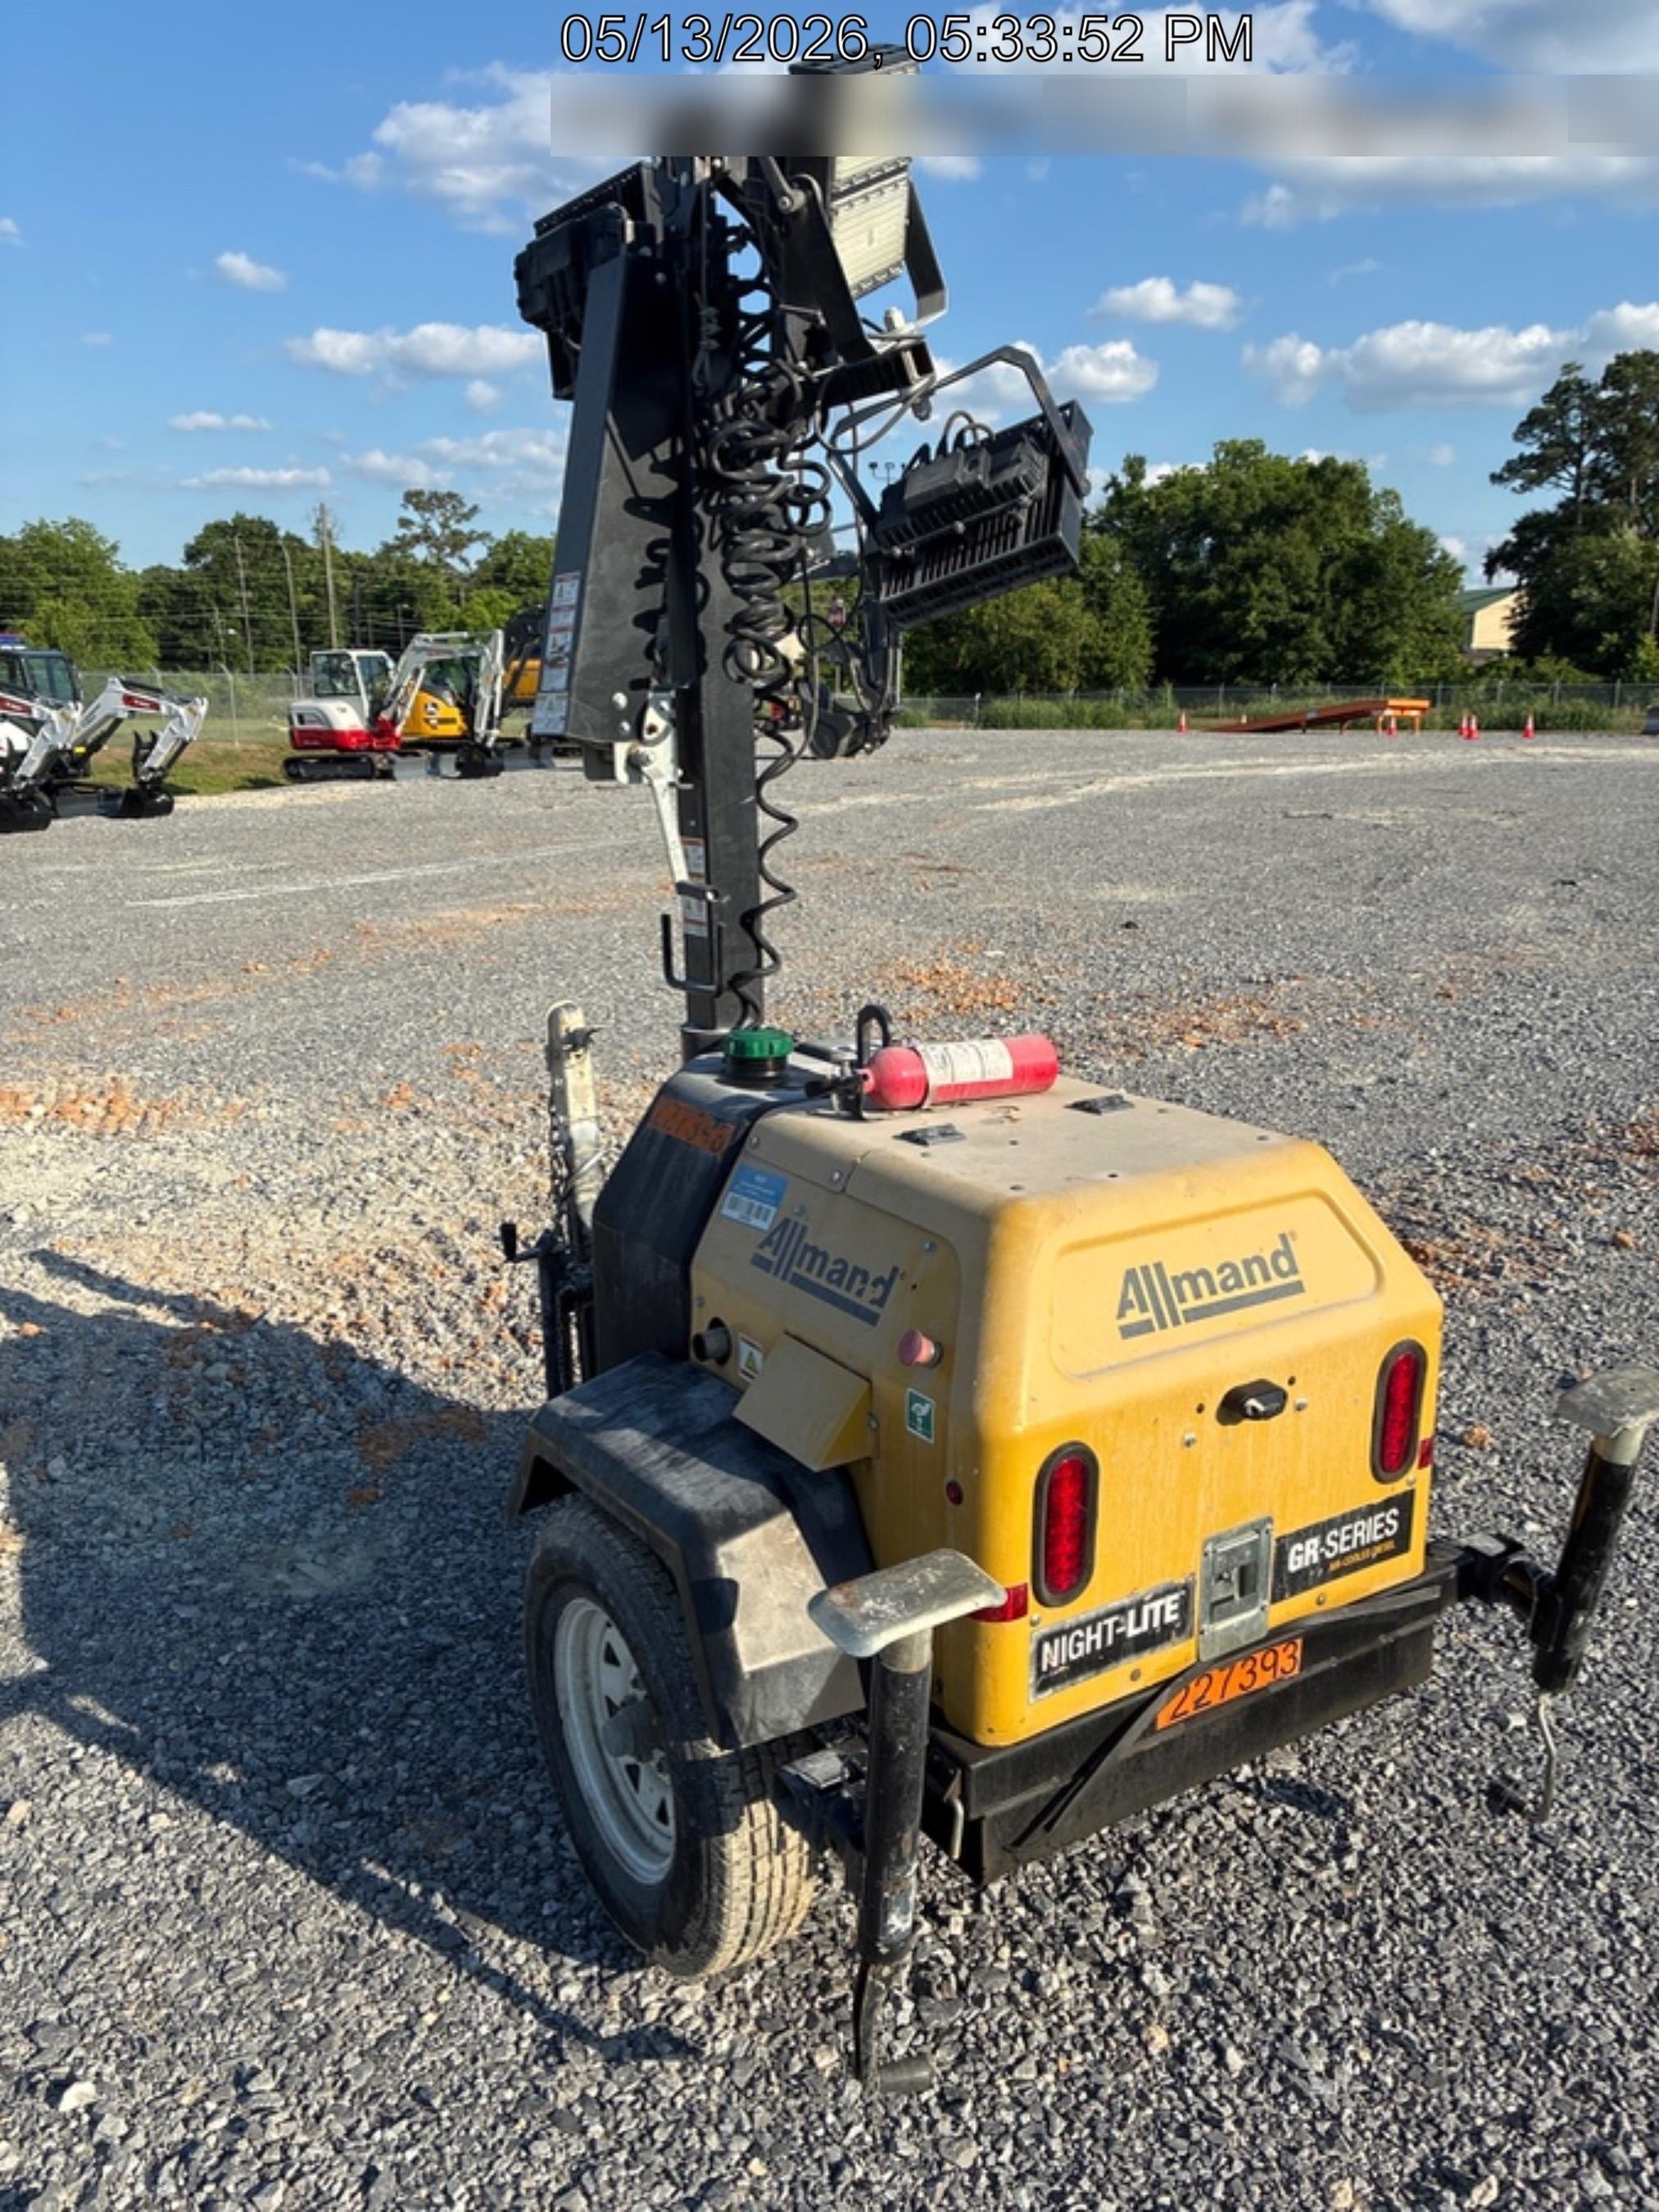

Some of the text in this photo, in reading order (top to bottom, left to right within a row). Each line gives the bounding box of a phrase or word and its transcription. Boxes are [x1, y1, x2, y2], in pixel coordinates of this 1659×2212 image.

[757, 1217, 900, 1308] Allmand
[1116, 1232, 1299, 1330] Allmand
[1287, 1507, 1399, 1574] GR-SERIES
[1040, 1594, 1181, 1672] NIGHT-LITE
[1169, 1639, 1299, 1721] 227393
